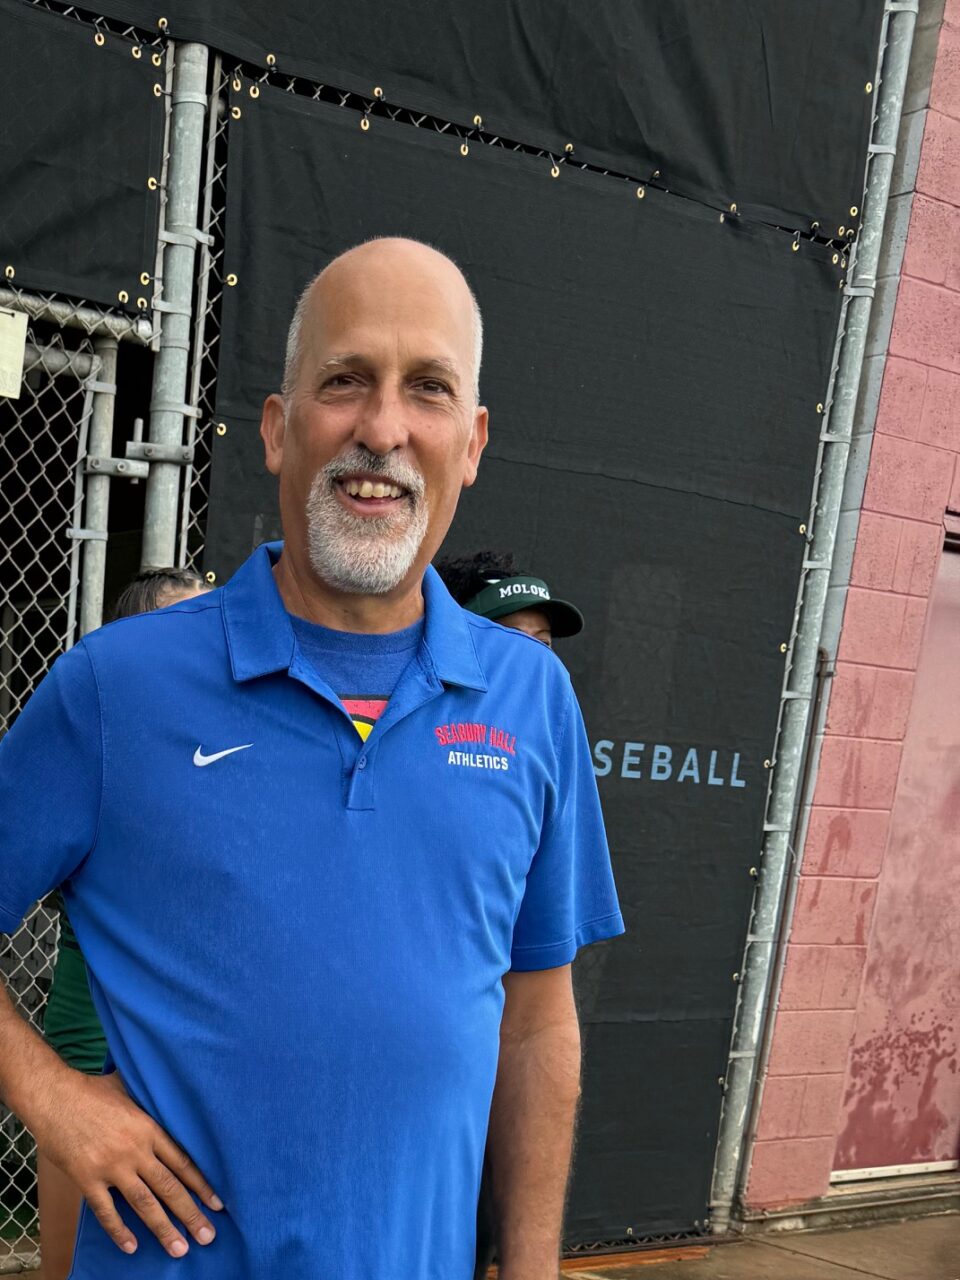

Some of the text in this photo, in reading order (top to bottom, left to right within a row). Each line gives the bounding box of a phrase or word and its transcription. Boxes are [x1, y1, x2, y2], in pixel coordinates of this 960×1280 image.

[434, 722, 517, 757] SEABURY HALL
[447, 750, 509, 771] ATHLETICS
[593, 739, 746, 788] SEBALL
